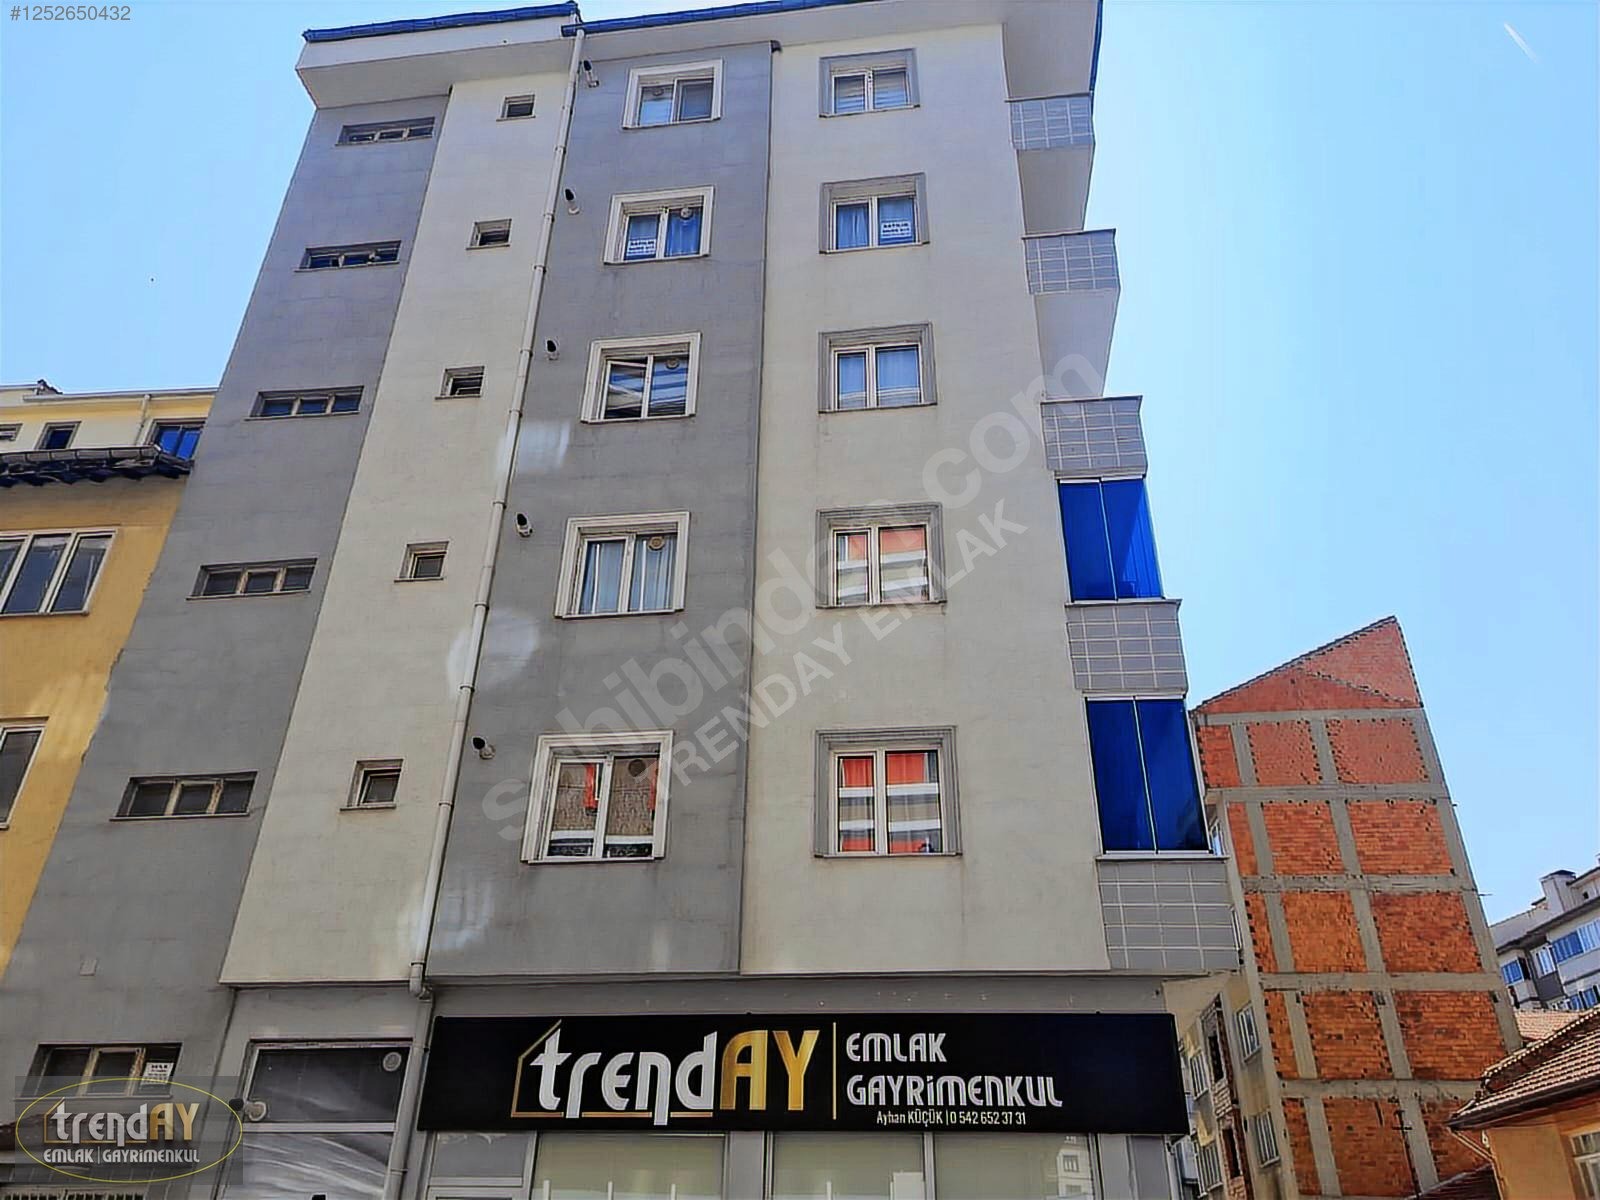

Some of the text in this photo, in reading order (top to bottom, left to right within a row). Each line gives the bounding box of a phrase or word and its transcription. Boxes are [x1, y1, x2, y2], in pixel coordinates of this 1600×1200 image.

[846, 1033, 947, 1062] EMLAK
[877, 1111, 905, 1126] Ayhan
[908, 1109, 943, 1127] KÜÇÜK
[959, 1112, 979, 1124] 542
[980, 1112, 1000, 1124] 652
[1001, 1112, 1013, 1125] 37
[1015, 1112, 1026, 1125] 31
